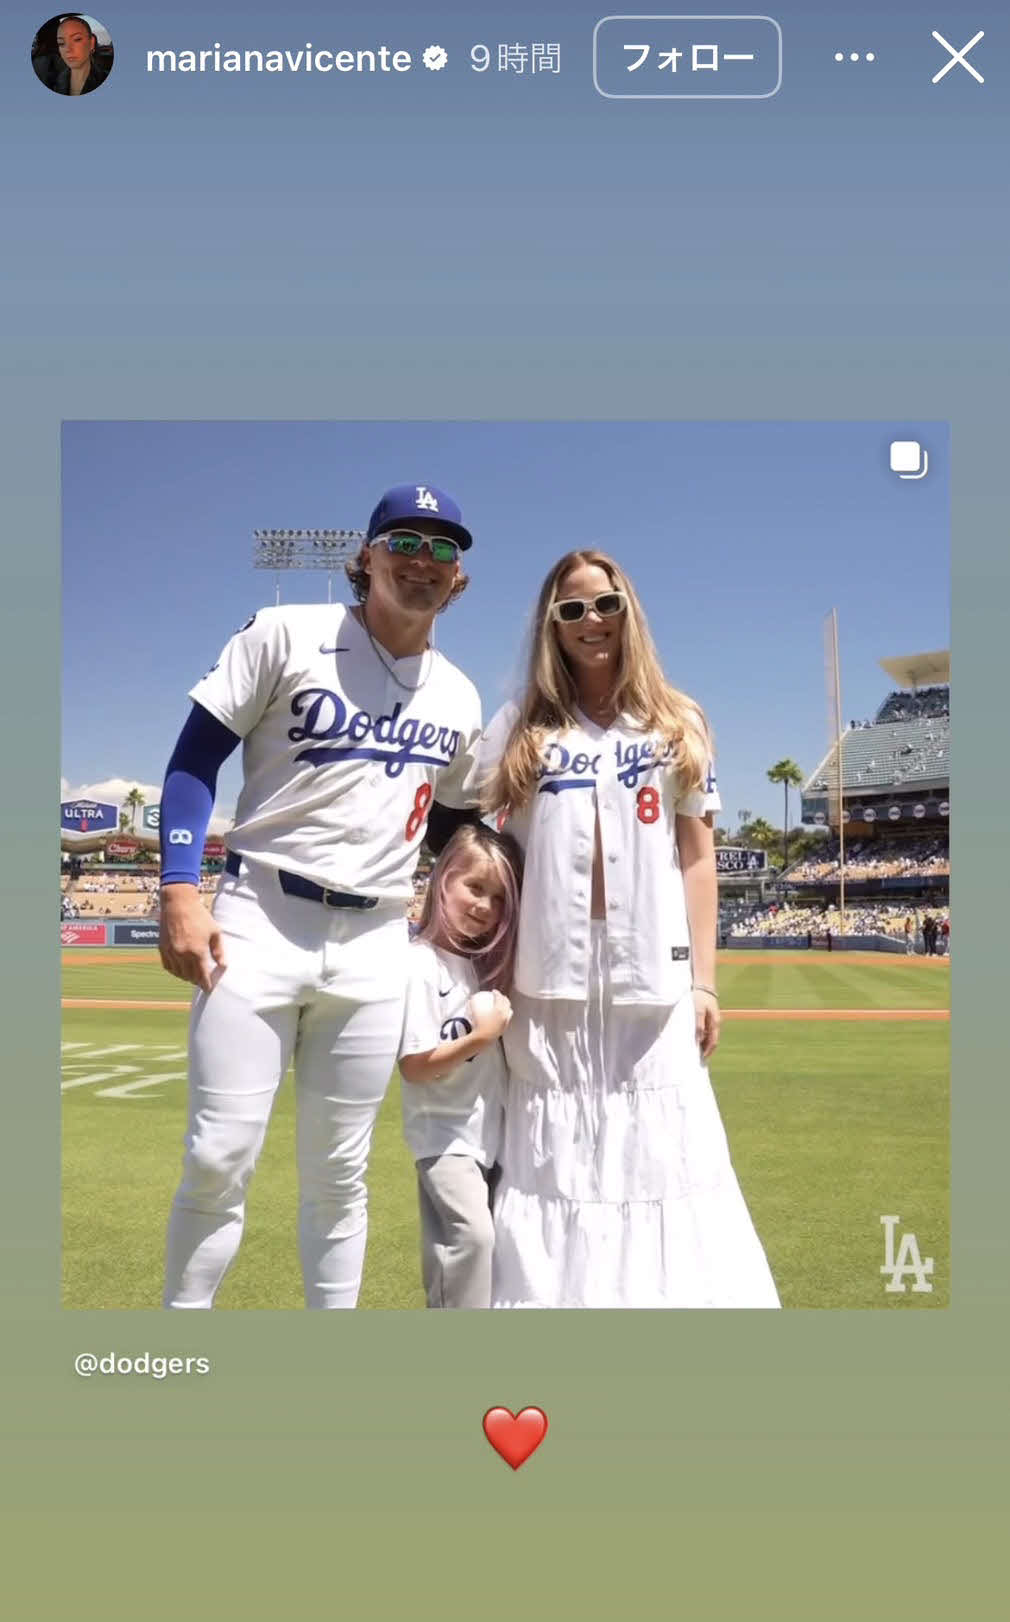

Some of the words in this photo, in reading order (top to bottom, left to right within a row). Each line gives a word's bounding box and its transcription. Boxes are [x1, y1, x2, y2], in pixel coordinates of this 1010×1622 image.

[415, 486, 440, 512] LA
[288, 688, 461, 778] Dodgers
[537, 740, 680, 789] Dodges
[64, 808, 104, 819] ULTRA
[405, 782, 433, 842] 8
[636, 786, 661, 825] 8
